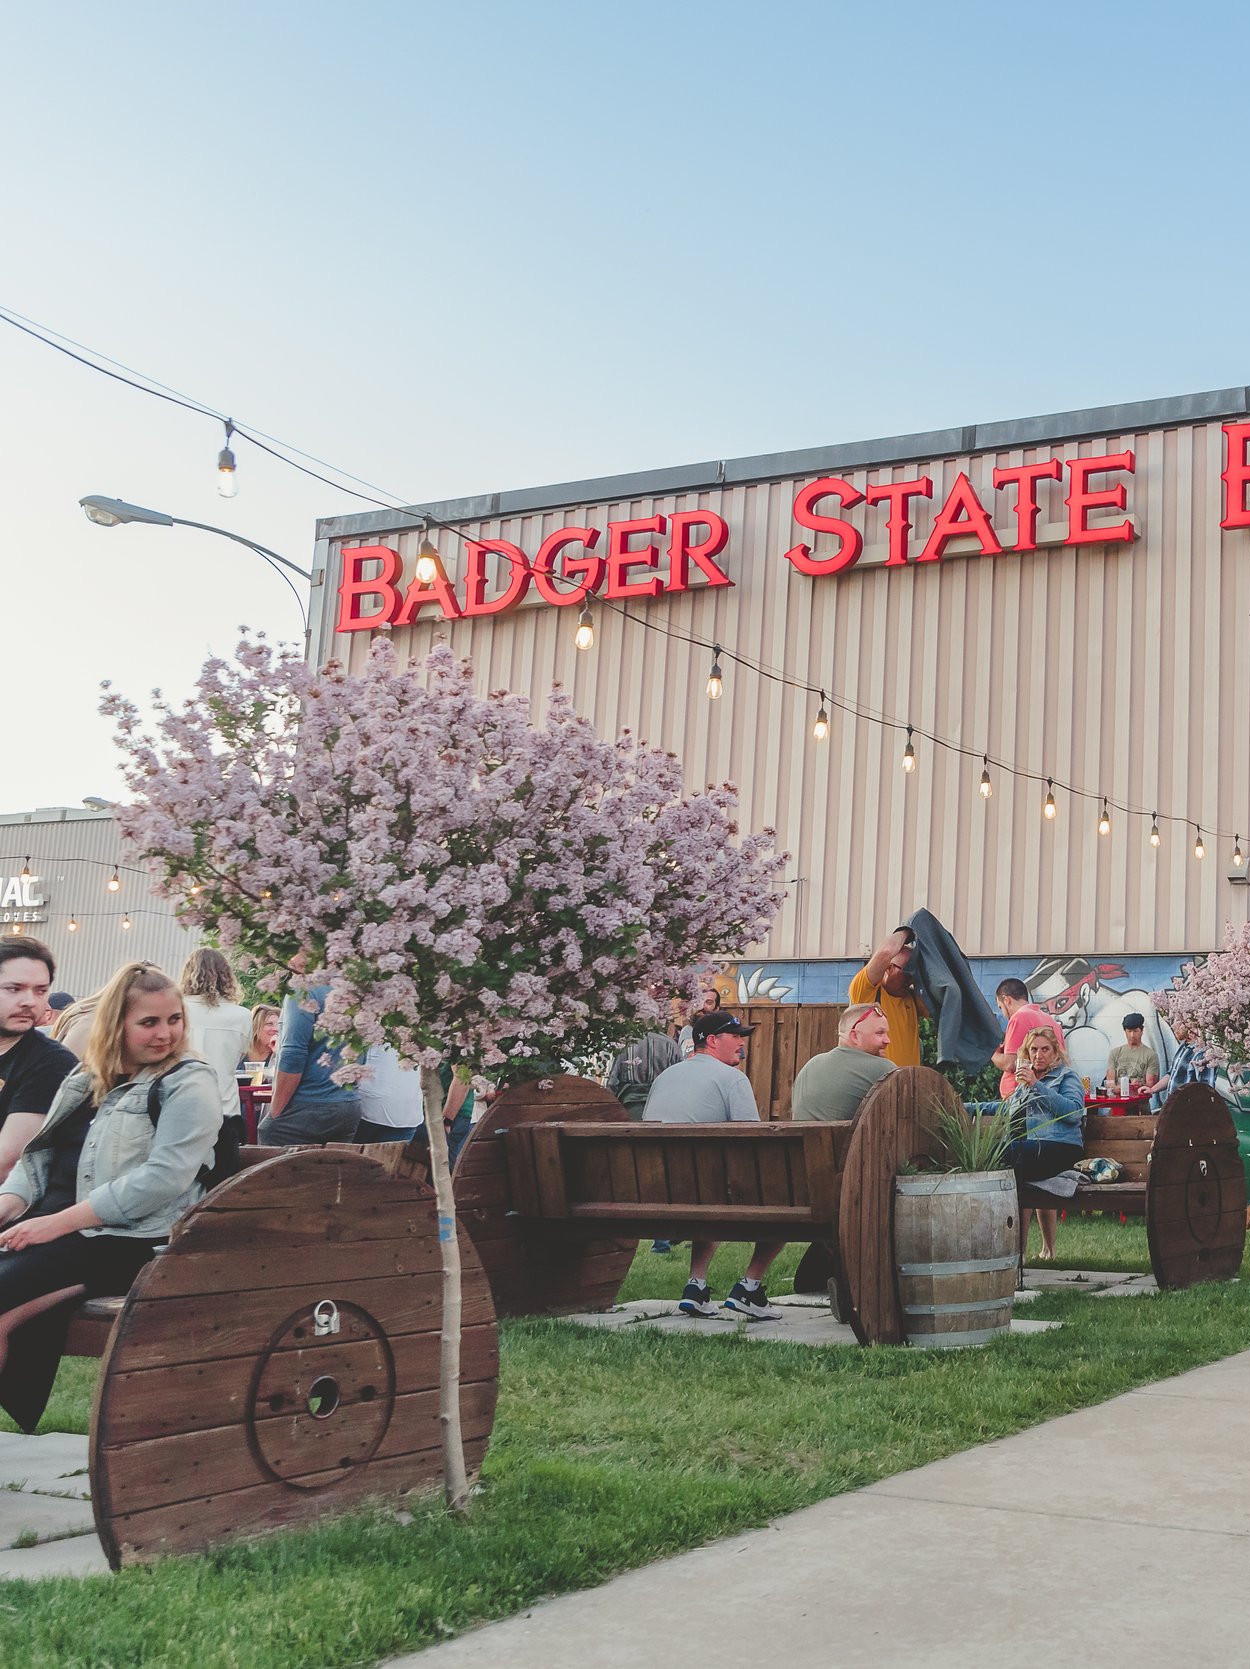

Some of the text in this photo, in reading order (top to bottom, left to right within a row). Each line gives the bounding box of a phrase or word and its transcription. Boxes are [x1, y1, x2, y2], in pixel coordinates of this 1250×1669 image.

[336, 510, 734, 633] BADGER
[784, 450, 1137, 578] STATE
[0, 876, 44, 907] AC
